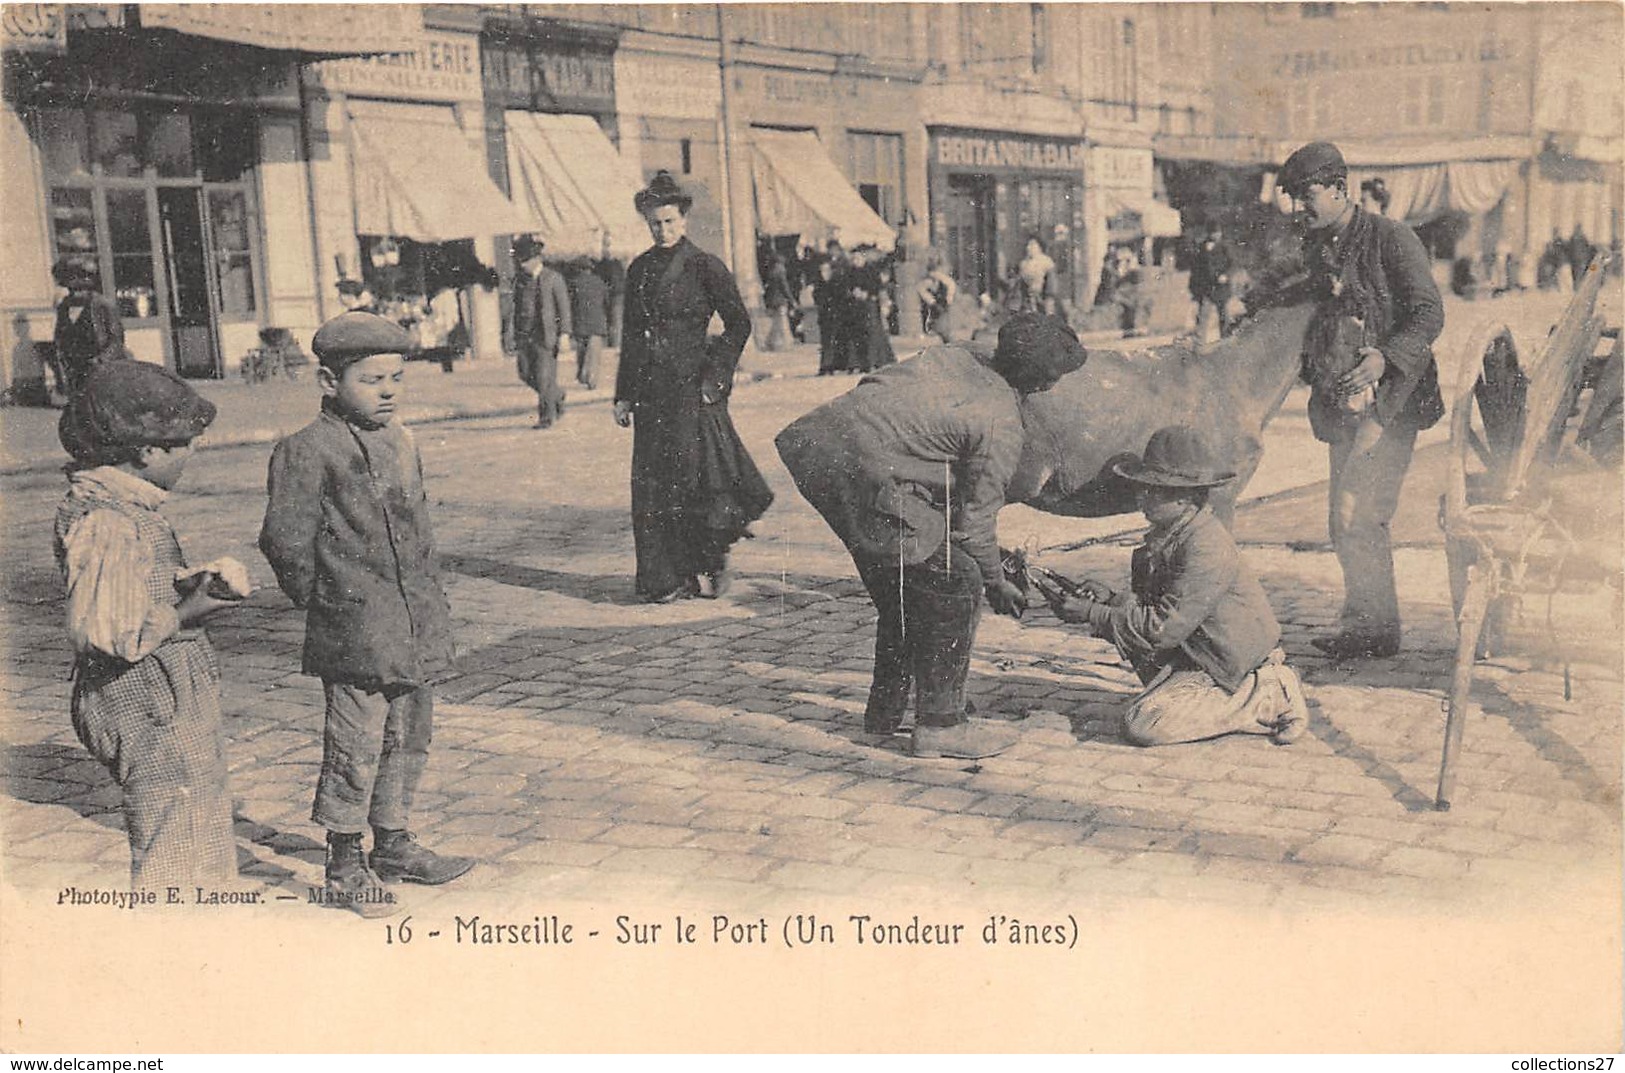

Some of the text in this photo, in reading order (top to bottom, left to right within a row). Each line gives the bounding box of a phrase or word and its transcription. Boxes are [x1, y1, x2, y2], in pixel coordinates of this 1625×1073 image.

[57, 887, 157, 910] Phototypie
[166, 887, 185, 904] E.
[196, 887, 266, 905] Lacour.
[306, 887, 397, 904] Marseille.
[386, 915, 412, 944] 16
[455, 915, 573, 944] Marseille
[616, 916, 662, 944] Sur
[676, 916, 696, 944] le
[712, 915, 768, 944] Port
[783, 914, 834, 948] (Un
[849, 915, 964, 945] Tondeur
[982, 914, 1078, 949] d’ânes)
